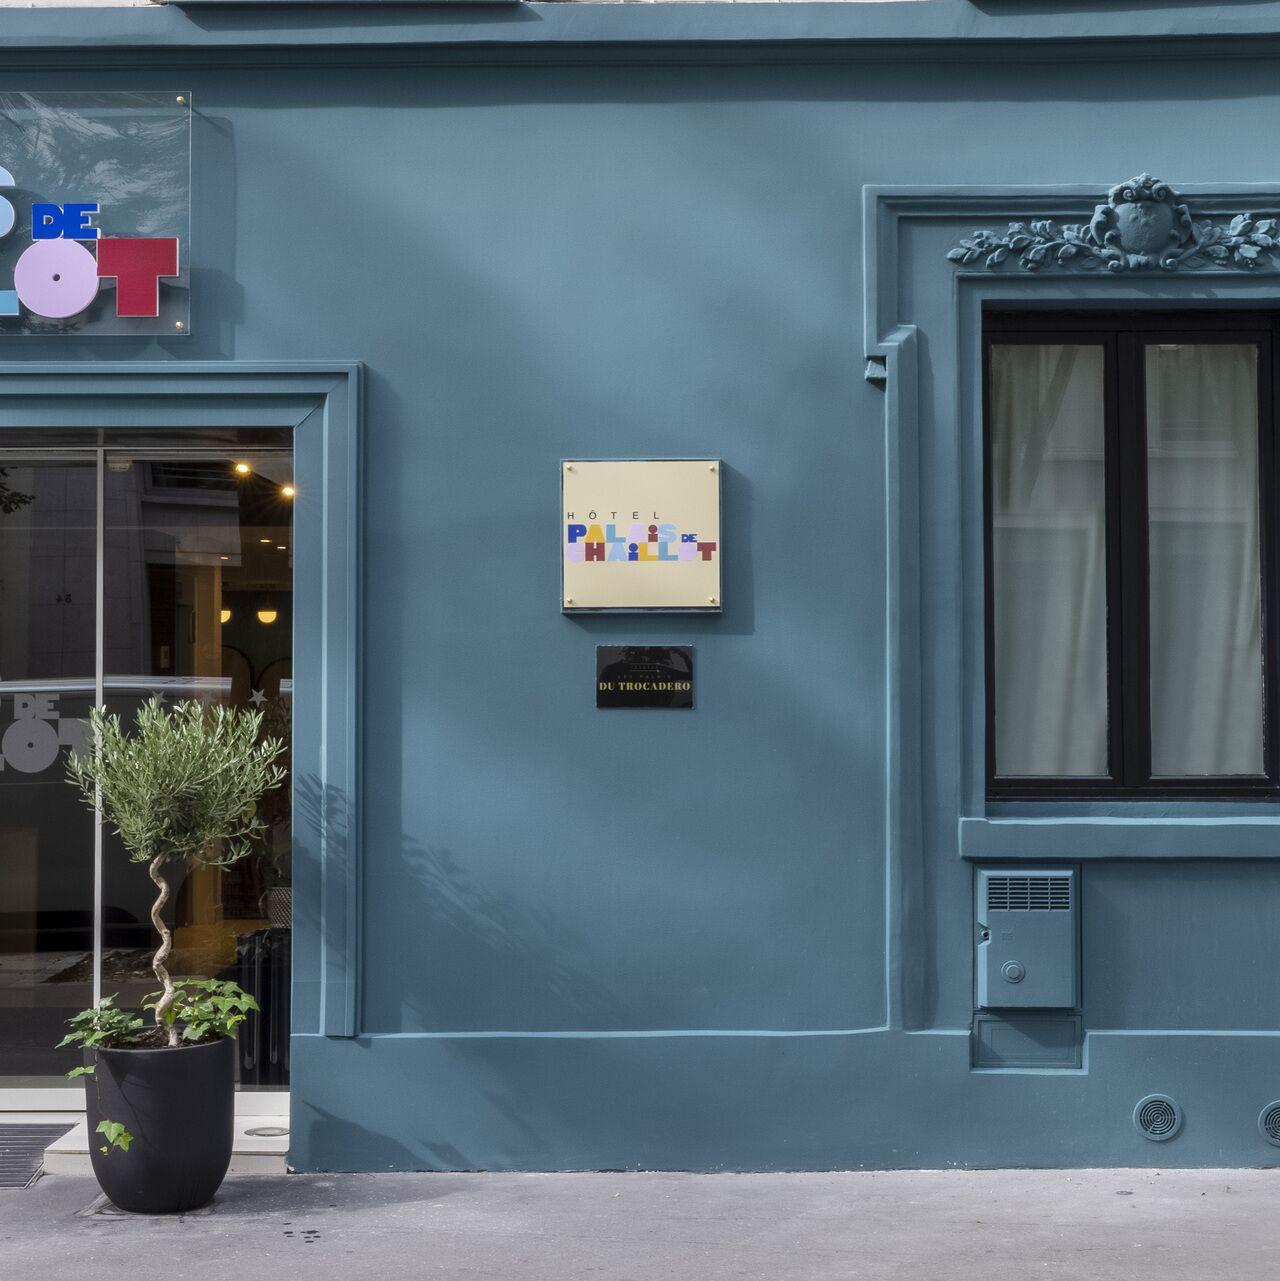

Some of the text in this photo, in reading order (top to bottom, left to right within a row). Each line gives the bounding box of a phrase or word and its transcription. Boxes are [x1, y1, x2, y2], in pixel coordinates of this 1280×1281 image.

[32, 203, 102, 240] DE
[567, 509, 660, 520] HÔTEL
[681, 533, 698, 544] DE
[599, 681, 691, 692] DU TROCADERO
[14, 693, 60, 720] DE
